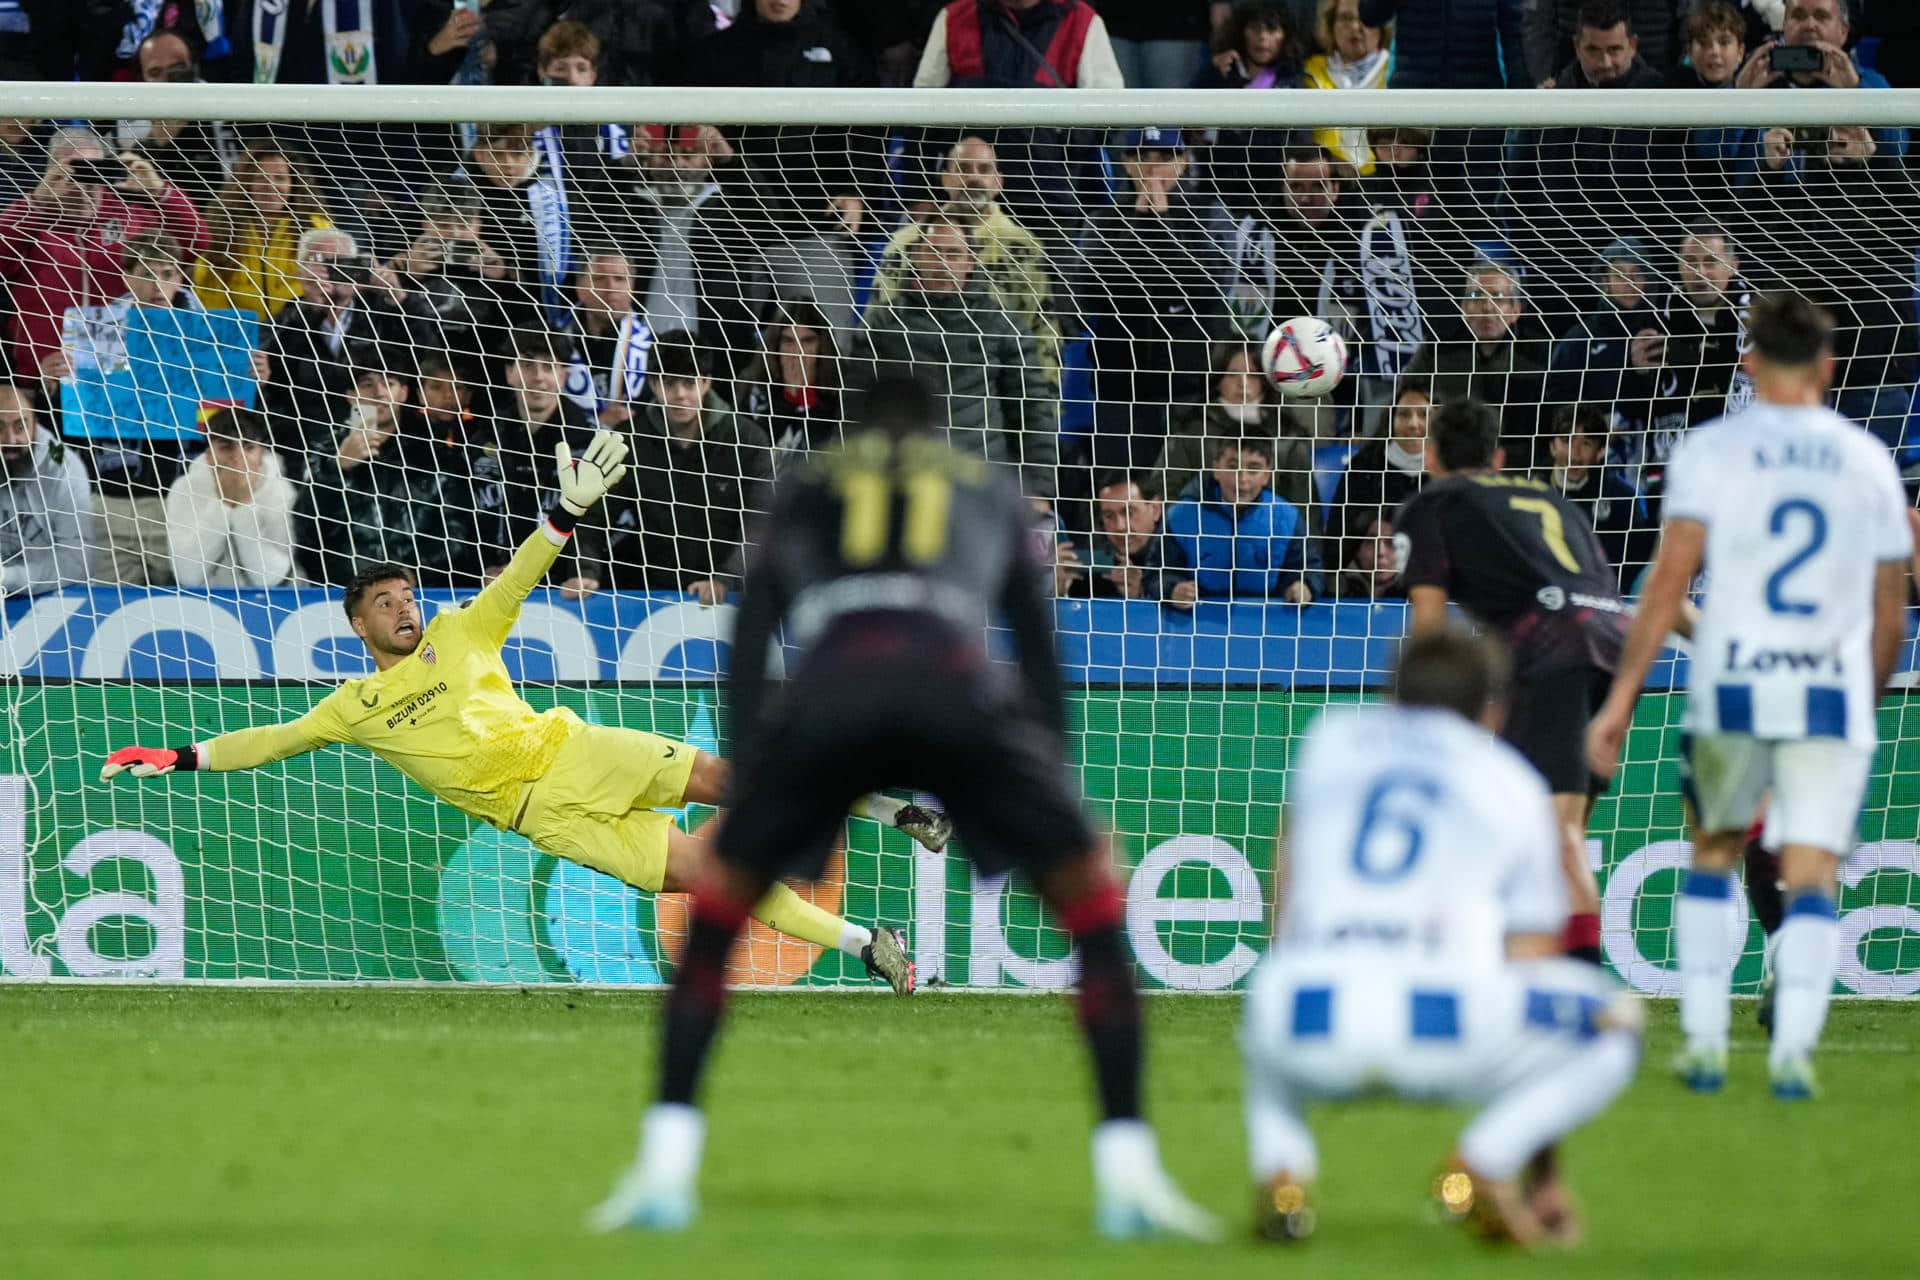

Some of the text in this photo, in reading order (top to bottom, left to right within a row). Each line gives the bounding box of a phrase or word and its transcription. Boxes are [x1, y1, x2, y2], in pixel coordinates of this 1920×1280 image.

[842, 468, 952, 568] 11
[1509, 495, 1582, 574] 7
[1765, 497, 1828, 615] 2
[386, 702, 418, 729] BIZUM
[417, 681, 448, 706] 02910
[1350, 768, 1443, 886] 6
